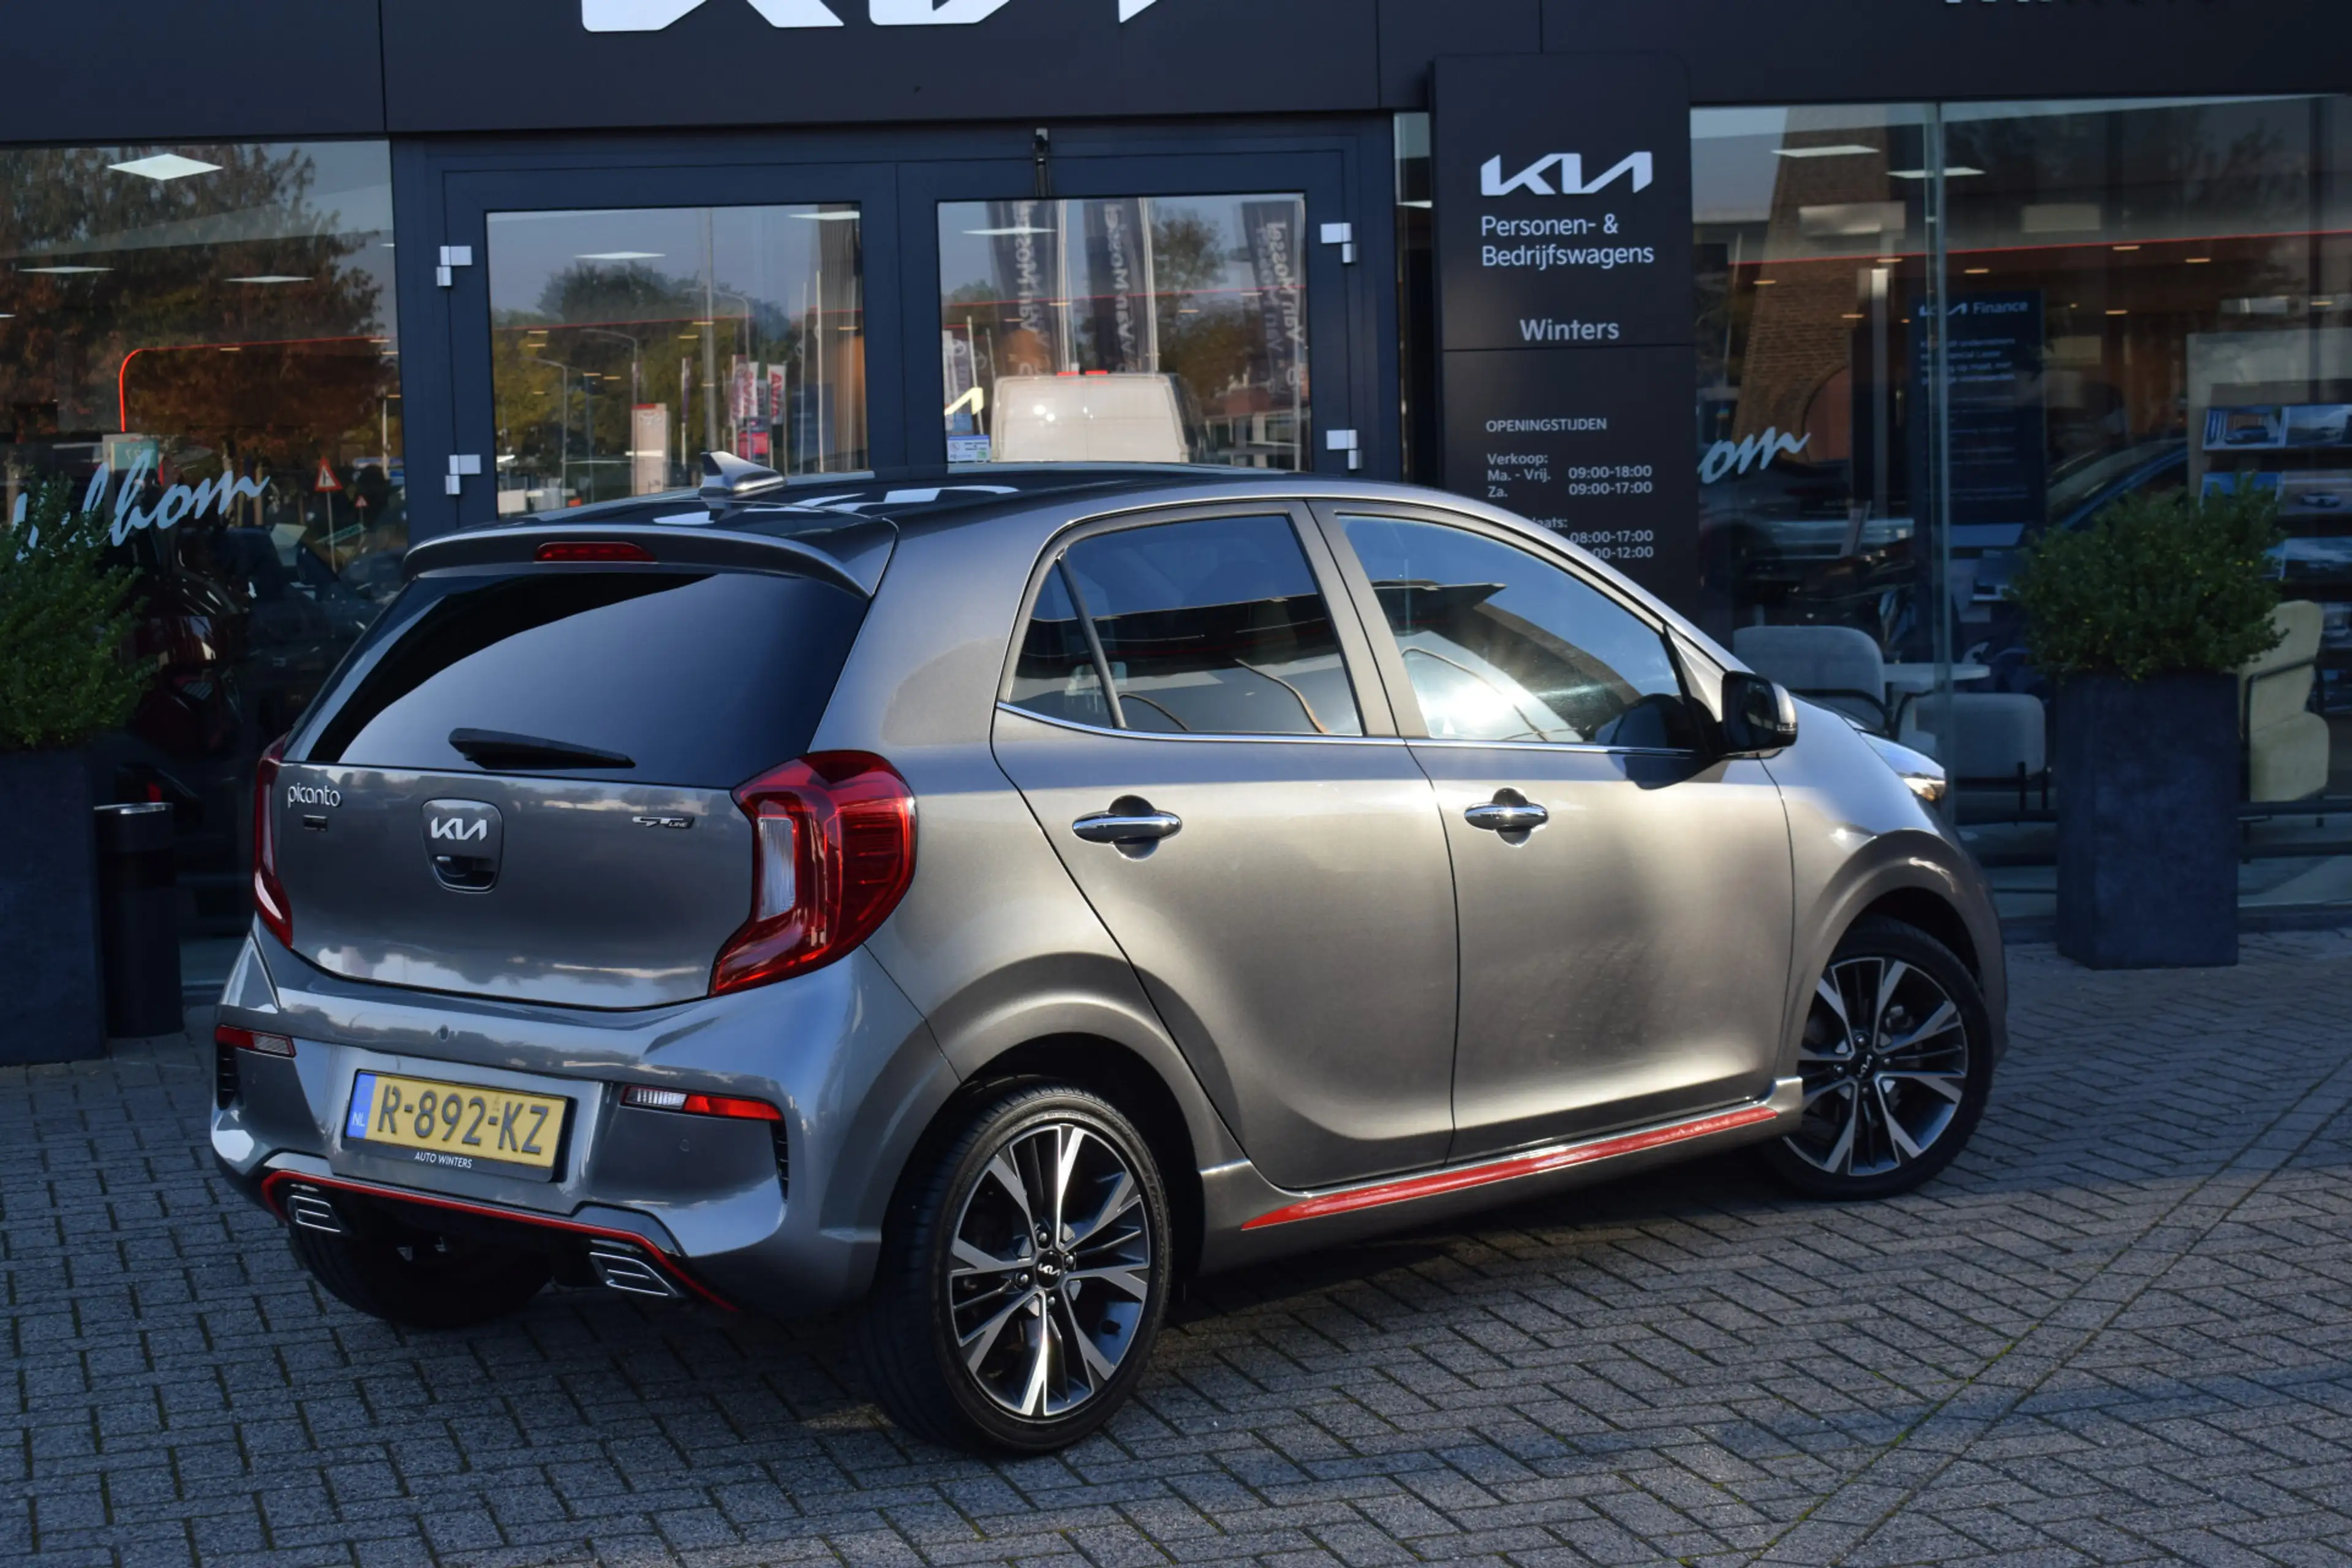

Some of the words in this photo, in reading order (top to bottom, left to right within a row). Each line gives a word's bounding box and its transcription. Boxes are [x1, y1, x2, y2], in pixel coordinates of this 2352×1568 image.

[1480, 151, 1653, 197] KIA
[1481, 215, 1596, 237] Personen-
[1603, 213, 1618, 235] &
[1482, 244, 1654, 270] Bedrijfswagens
[1973, 301, 2028, 315] Finance
[1520, 318, 1619, 341] Winters
[1487, 453, 1548, 466] Verkoop:
[1487, 469, 1512, 481] Ma.
[1523, 468, 1551, 483] Vrij.
[1568, 465, 1653, 480] 09:00-18:00
[1487, 486, 1508, 498] Za.
[1569, 481, 1653, 496] 09:00-17:00
[1569, 530, 1654, 544] 08:00-17:00
[287, 783, 341, 809] picanto
[431, 816, 488, 841] KIA
[352, 1112, 366, 1127] NL
[377, 1084, 549, 1155] R-892-KZ
[413, 1151, 437, 1164] AUTO
[438, 1155, 473, 1169] WINTERS
